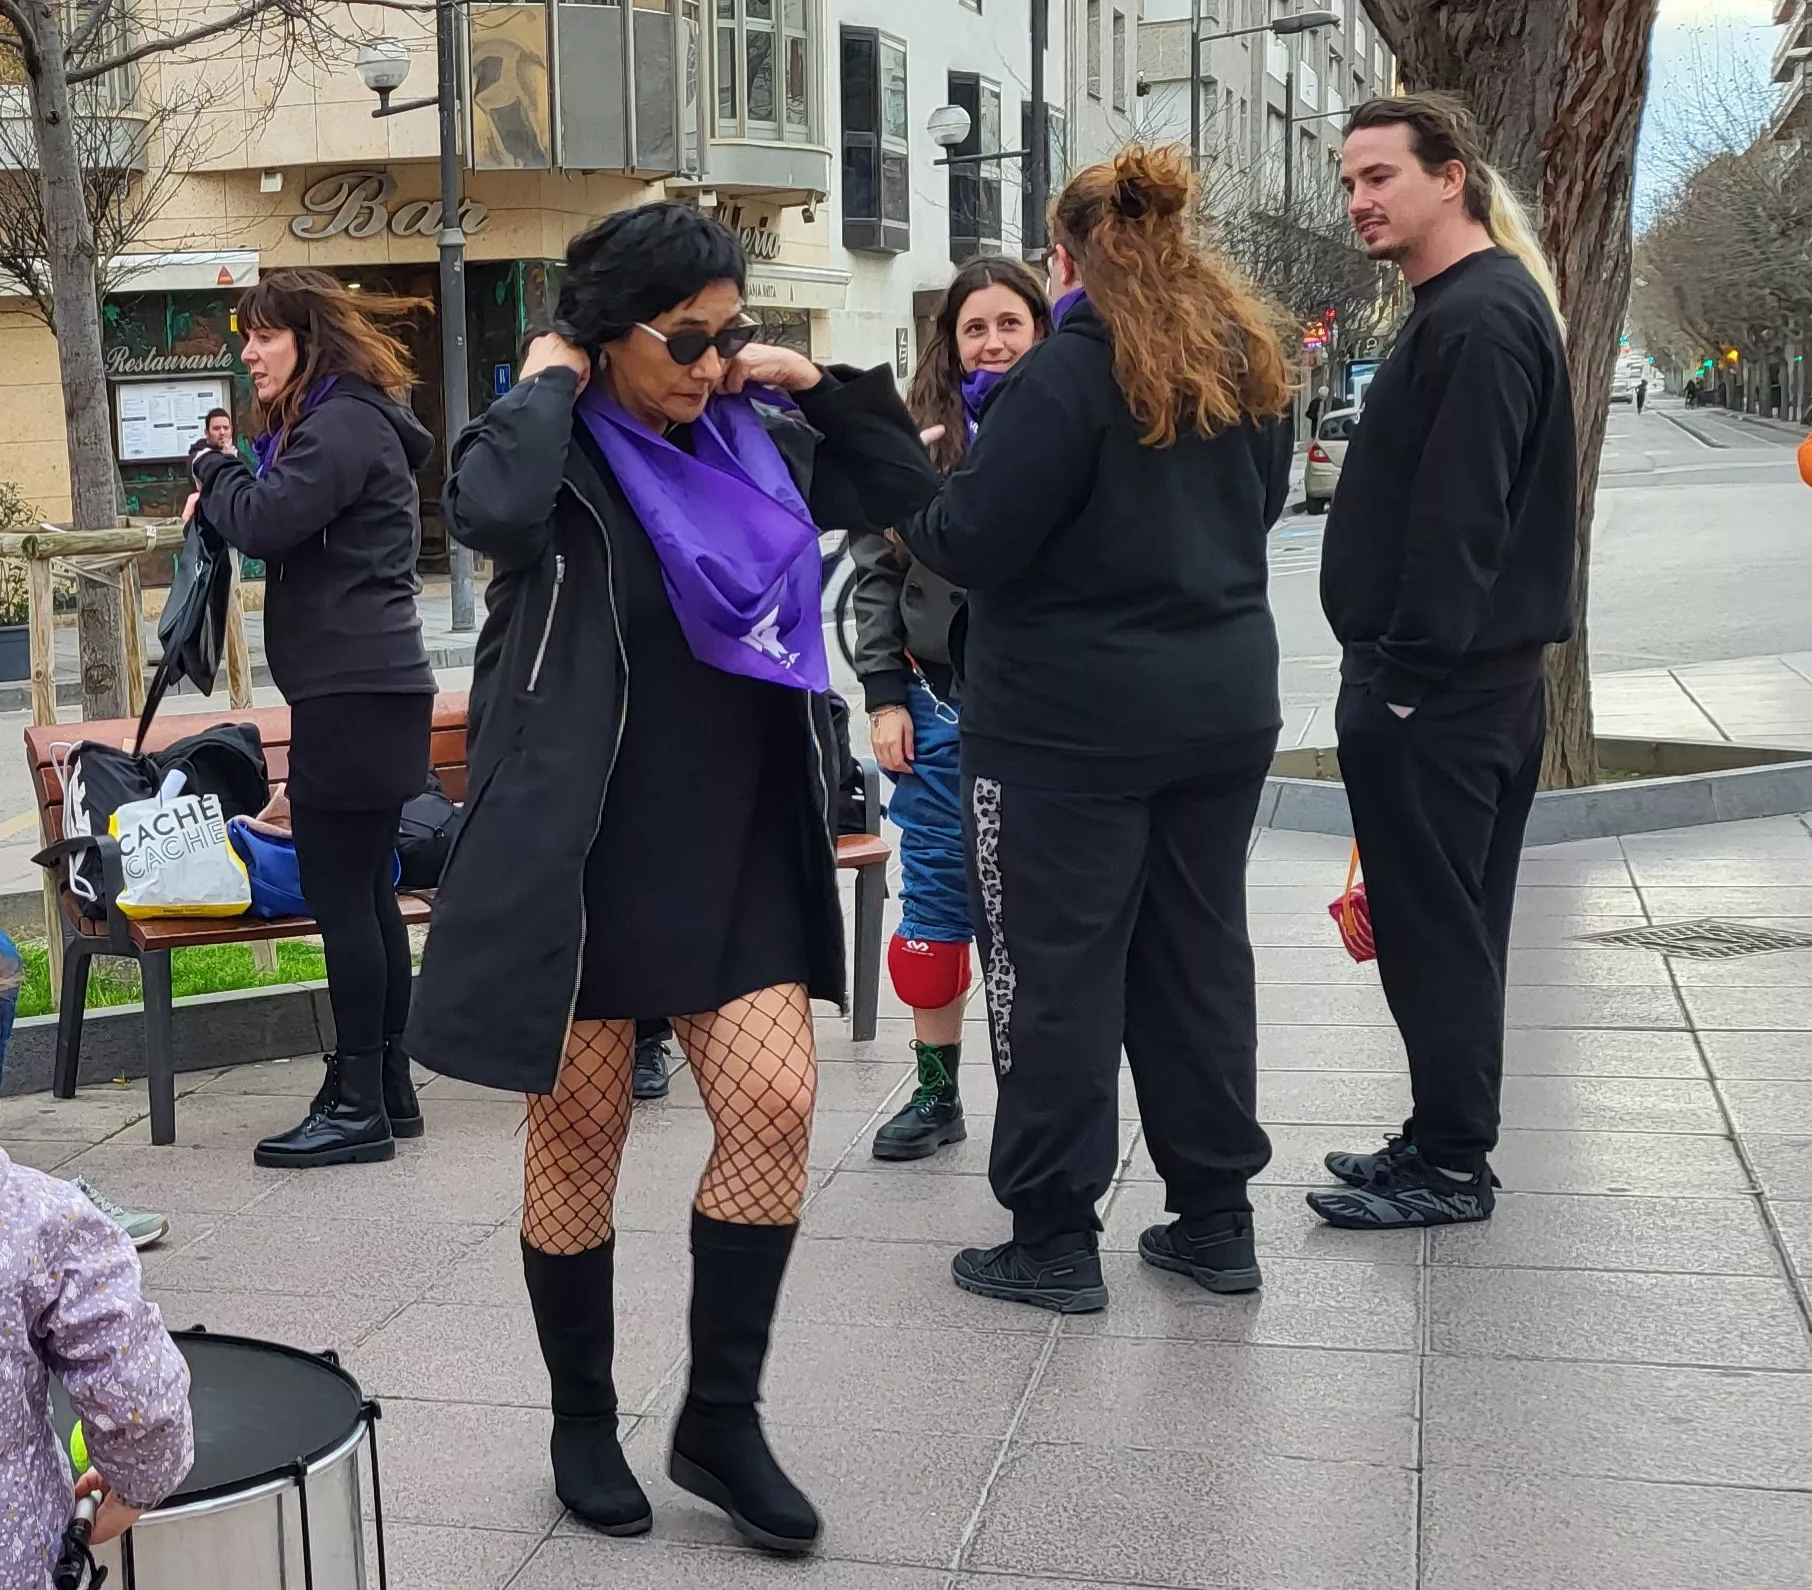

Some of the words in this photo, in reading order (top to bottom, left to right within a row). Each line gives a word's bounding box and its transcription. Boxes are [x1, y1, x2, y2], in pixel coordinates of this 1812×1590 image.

[291, 171, 490, 239] Bar
[104, 343, 233, 373] Restaurante
[119, 795, 220, 856] CACHE
[125, 820, 226, 879] CACHE
